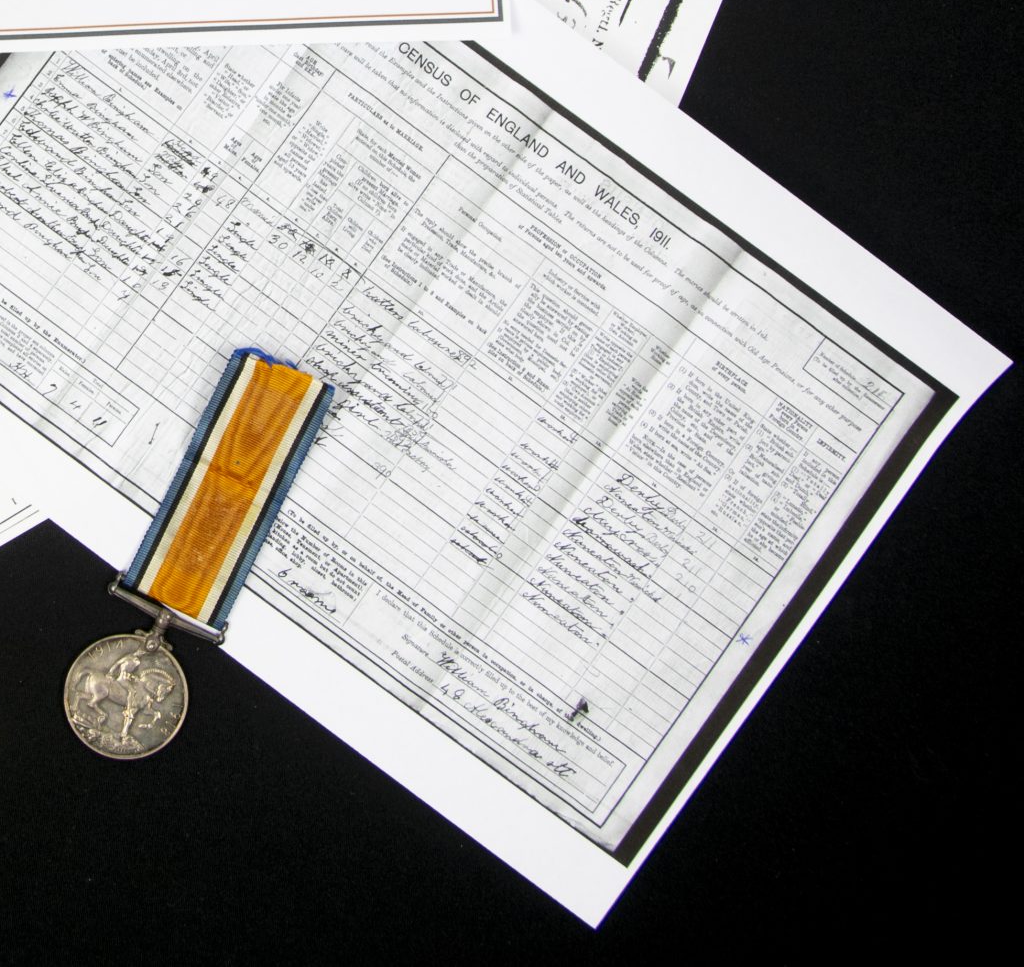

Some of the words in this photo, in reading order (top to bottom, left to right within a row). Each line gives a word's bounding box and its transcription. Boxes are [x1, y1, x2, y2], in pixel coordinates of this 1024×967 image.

[398, 41, 453, 87] CENSUS
[459, 88, 481, 105] OF
[485, 107, 550, 159] ENGLAND
[555, 160, 586, 185] AND
[594, 184, 641, 230] WALES,
